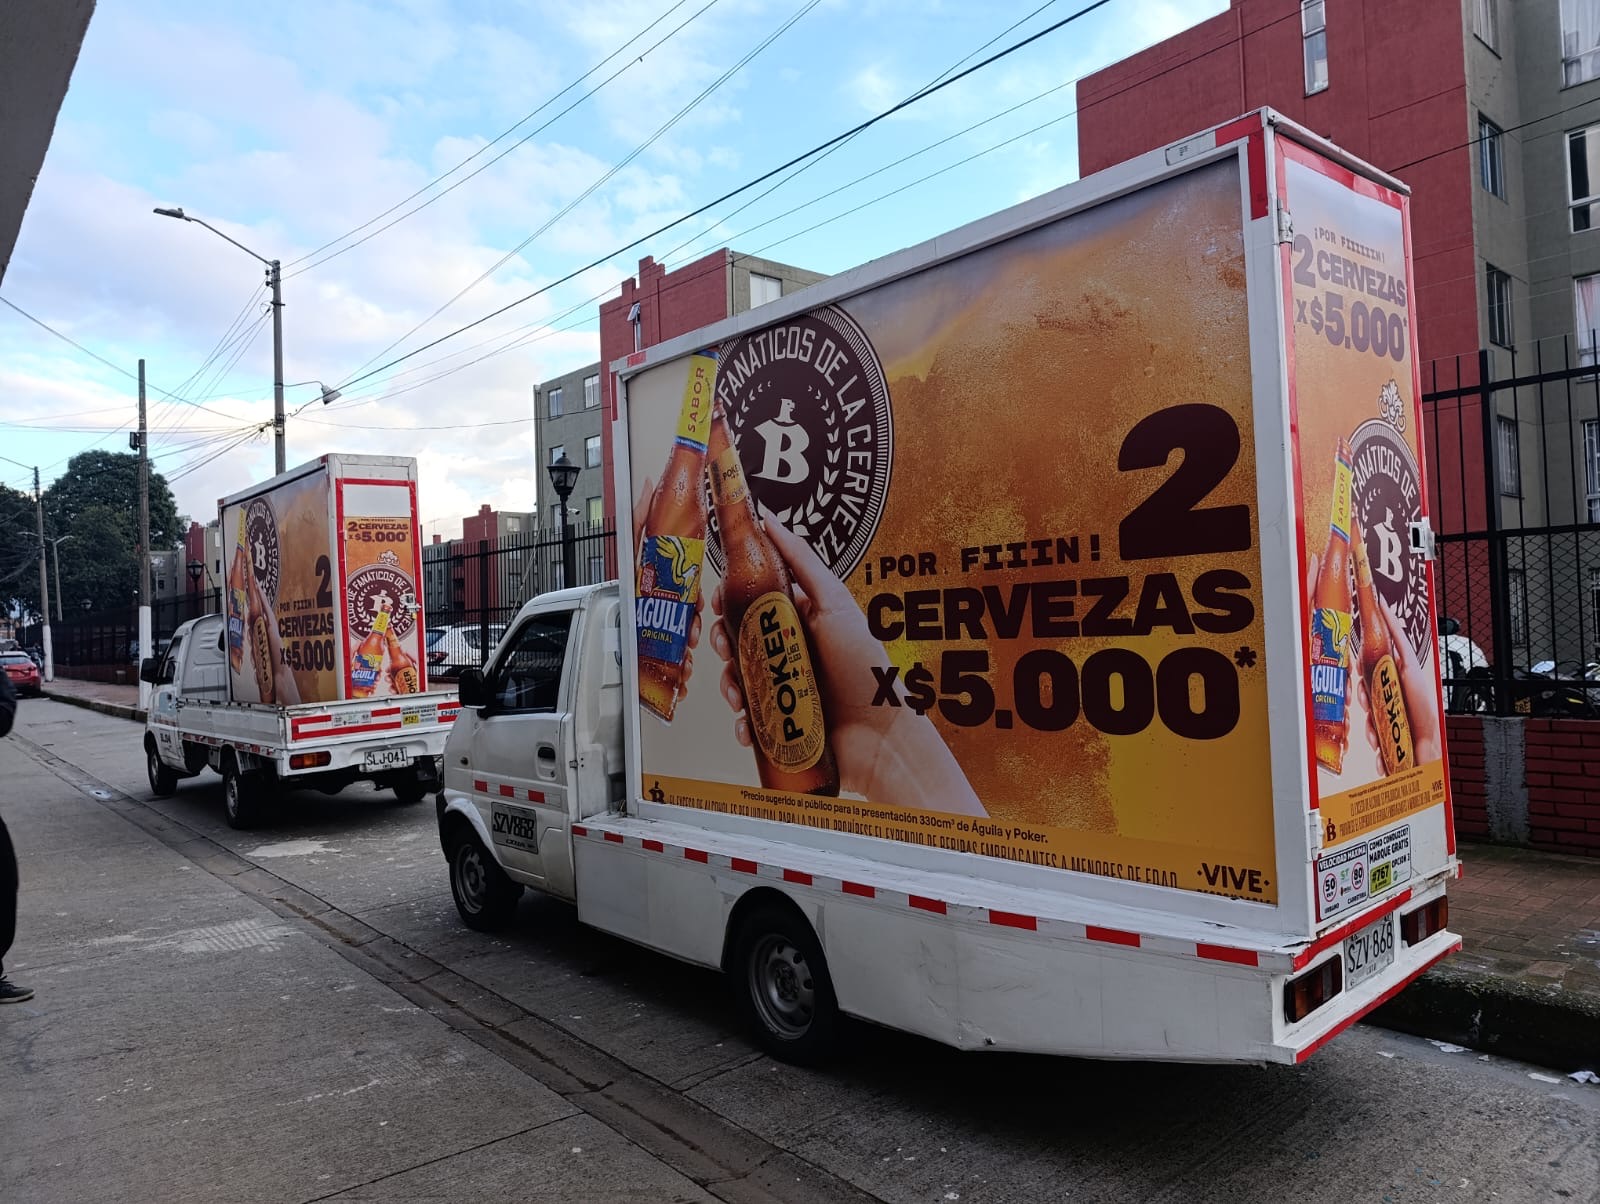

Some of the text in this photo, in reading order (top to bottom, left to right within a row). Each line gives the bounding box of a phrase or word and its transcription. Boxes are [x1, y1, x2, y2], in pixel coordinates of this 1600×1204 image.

[1293, 233, 1406, 307] 2 CERVEZAS
[687, 366, 705, 433] SABOR
[717, 326, 872, 567] FANÁTICOS DE LA CERVEZA
[1117, 402, 1252, 561] 2
[348, 521, 358, 531] 2
[1351, 444, 1428, 652] FANÁTICOS DE L ERVEZA
[315, 555, 333, 608] 2
[393, 577, 407, 589] DE
[402, 586, 411, 594] L
[865, 552, 938, 585] ¡POR
[278, 612, 335, 638] CERVEZAS
[866, 568, 1255, 642] CERVEZAS
[641, 628, 673, 643] ORIGINAL
[403, 670, 416, 694] OKER
[760, 605, 804, 742] POKER
[1380, 666, 1406, 763] POKER
[765, 794, 796, 806] sugerido
[797, 798, 804, 807] al
[804, 799, 833, 812] público
[833, 804, 852, 815] para
[852, 805, 860, 815] la
[861, 808, 918, 824] presentación
[956, 820, 970, 832] de
[971, 819, 1003, 837] Águila
[1004, 828, 1012, 840] y
[1013, 827, 1049, 843] Poker.
[1353, 867, 1363, 880] 80
[1369, 837, 1409, 864] MARQUE GRATIS
[1325, 878, 1336, 892] 50
